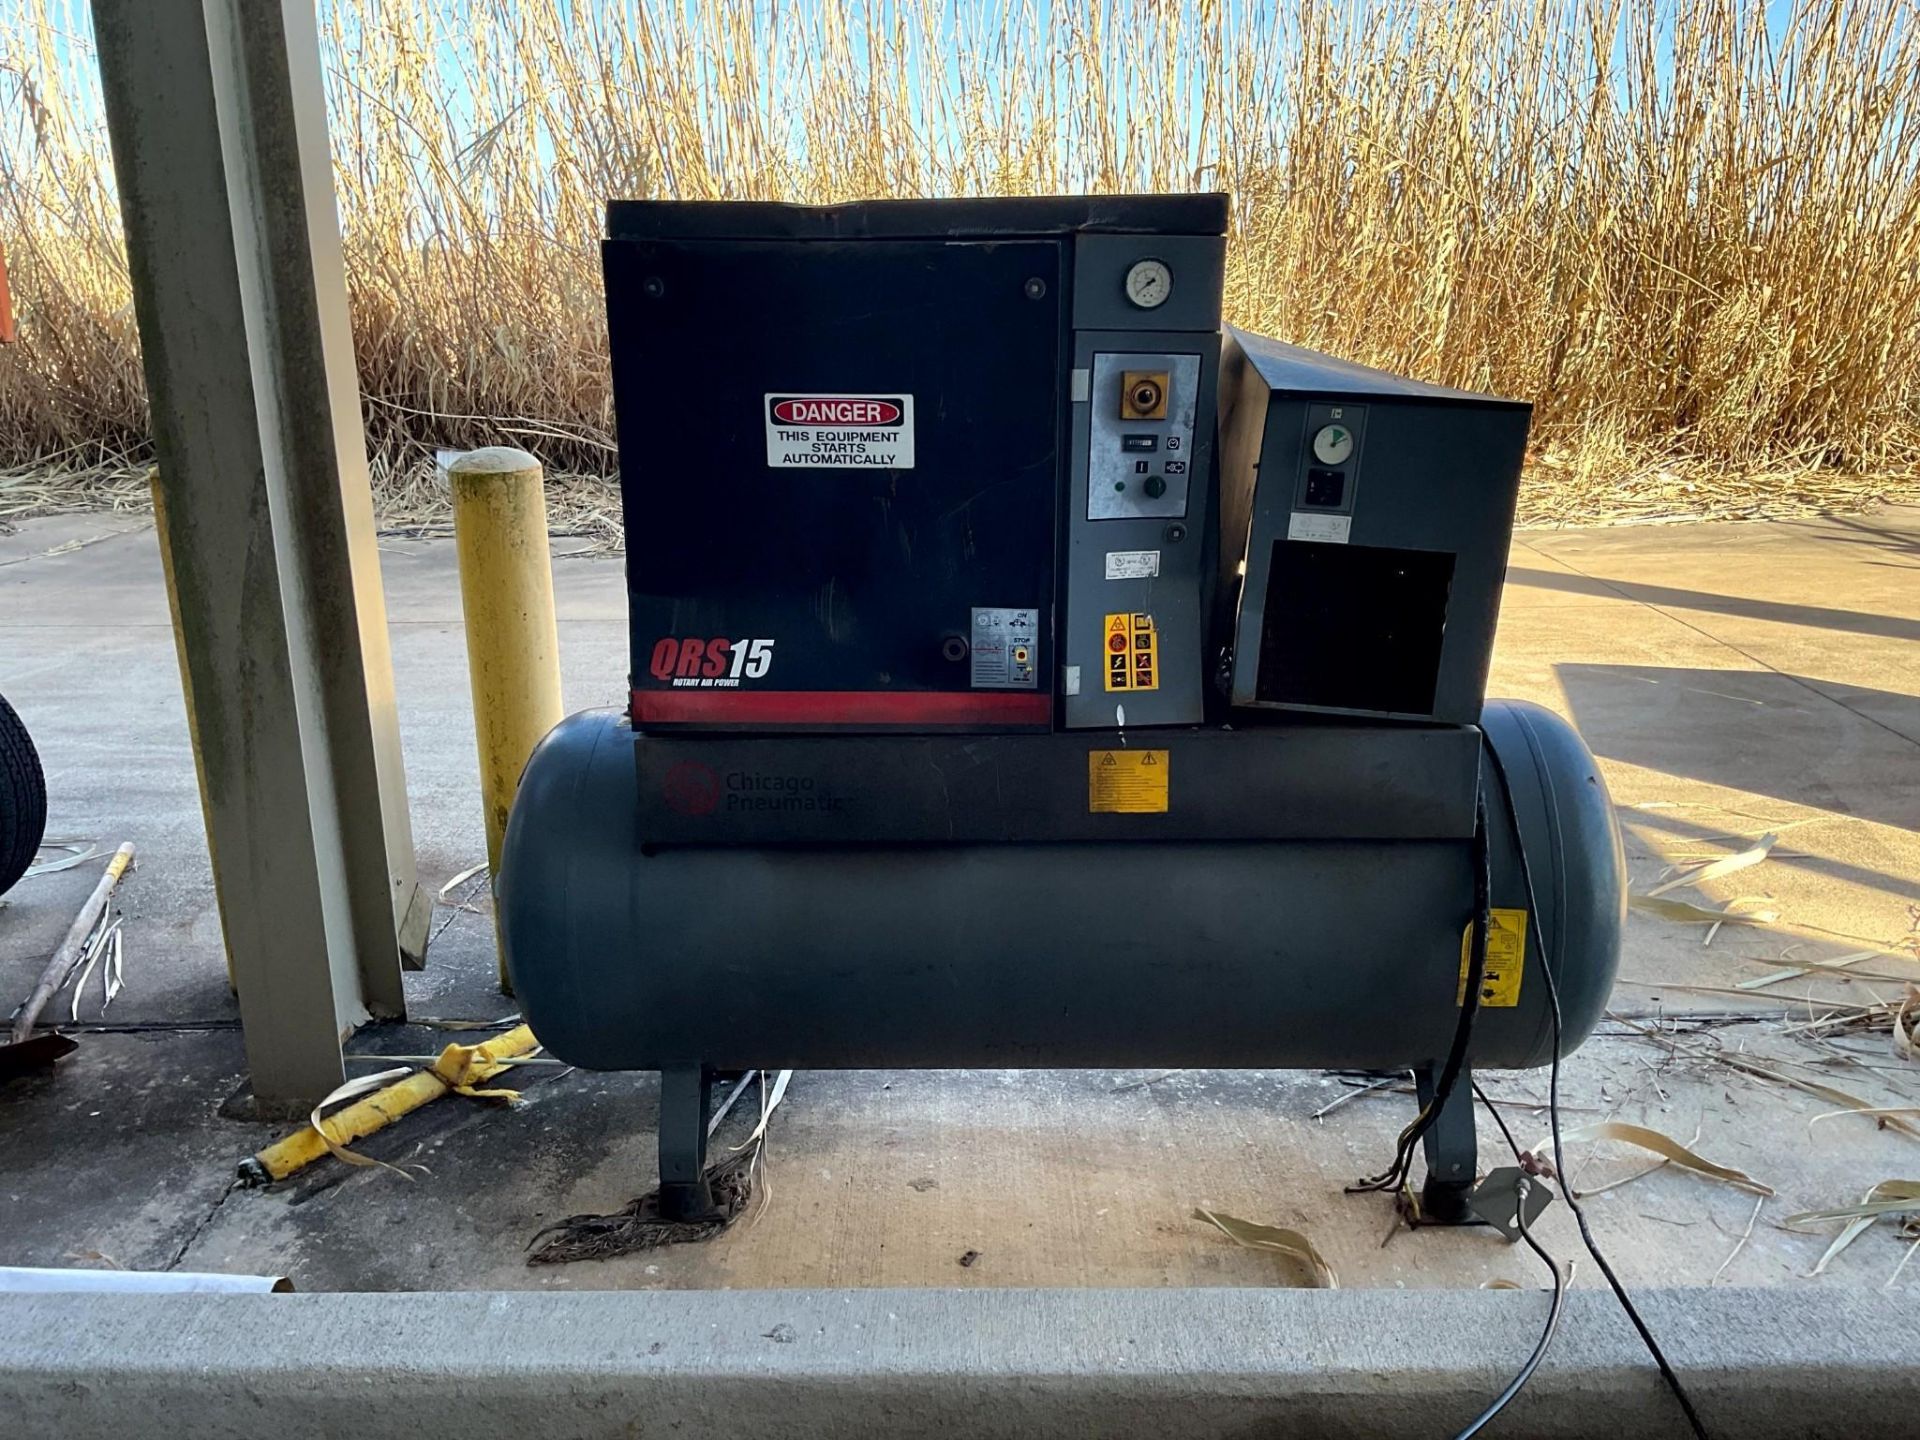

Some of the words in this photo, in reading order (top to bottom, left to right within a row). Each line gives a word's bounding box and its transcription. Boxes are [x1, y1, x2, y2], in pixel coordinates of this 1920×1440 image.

[792, 402, 881, 422] DANGER
[777, 431, 810, 441] THIS
[816, 431, 899, 442] EQUIPMENT
[811, 443, 866, 453] STARTS
[782, 453, 896, 465] AUTOMATICALLY
[672, 678, 700, 687] ROTARY
[700, 678, 713, 687] AIR
[714, 678, 740, 687] POWER
[726, 772, 814, 796] Chicago
[726, 793, 843, 812] Pneumatic
